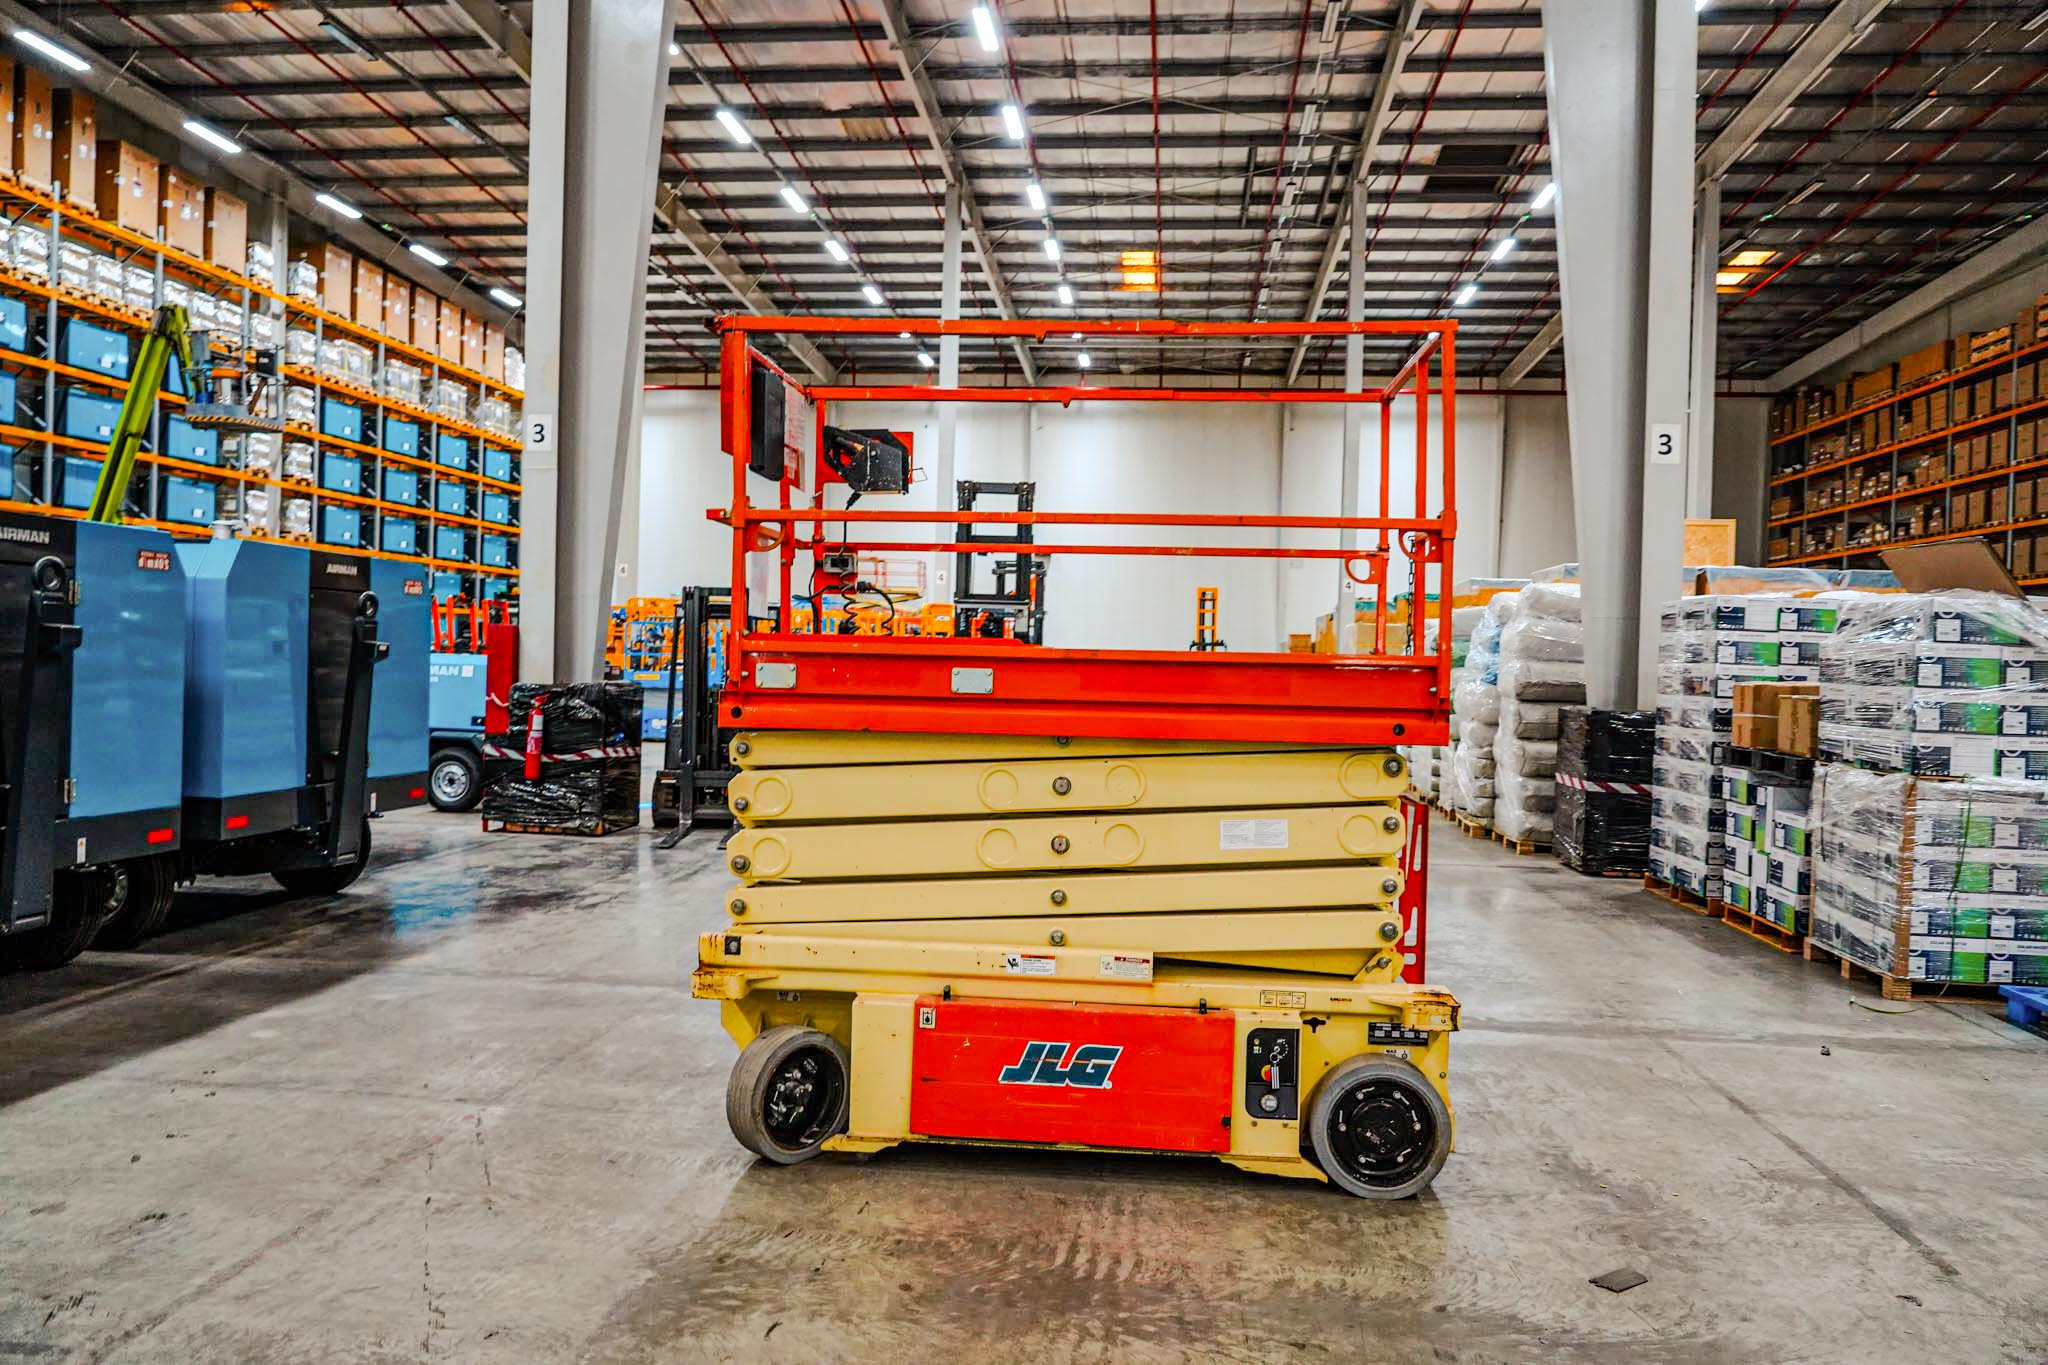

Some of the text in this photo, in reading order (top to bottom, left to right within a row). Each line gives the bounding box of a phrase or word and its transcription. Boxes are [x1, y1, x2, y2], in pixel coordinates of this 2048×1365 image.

[533, 423, 545, 443] 3
[1658, 433, 1672, 455] 3
[326, 563, 358, 576] AIRMAN
[998, 1041, 1124, 1089] JLG
